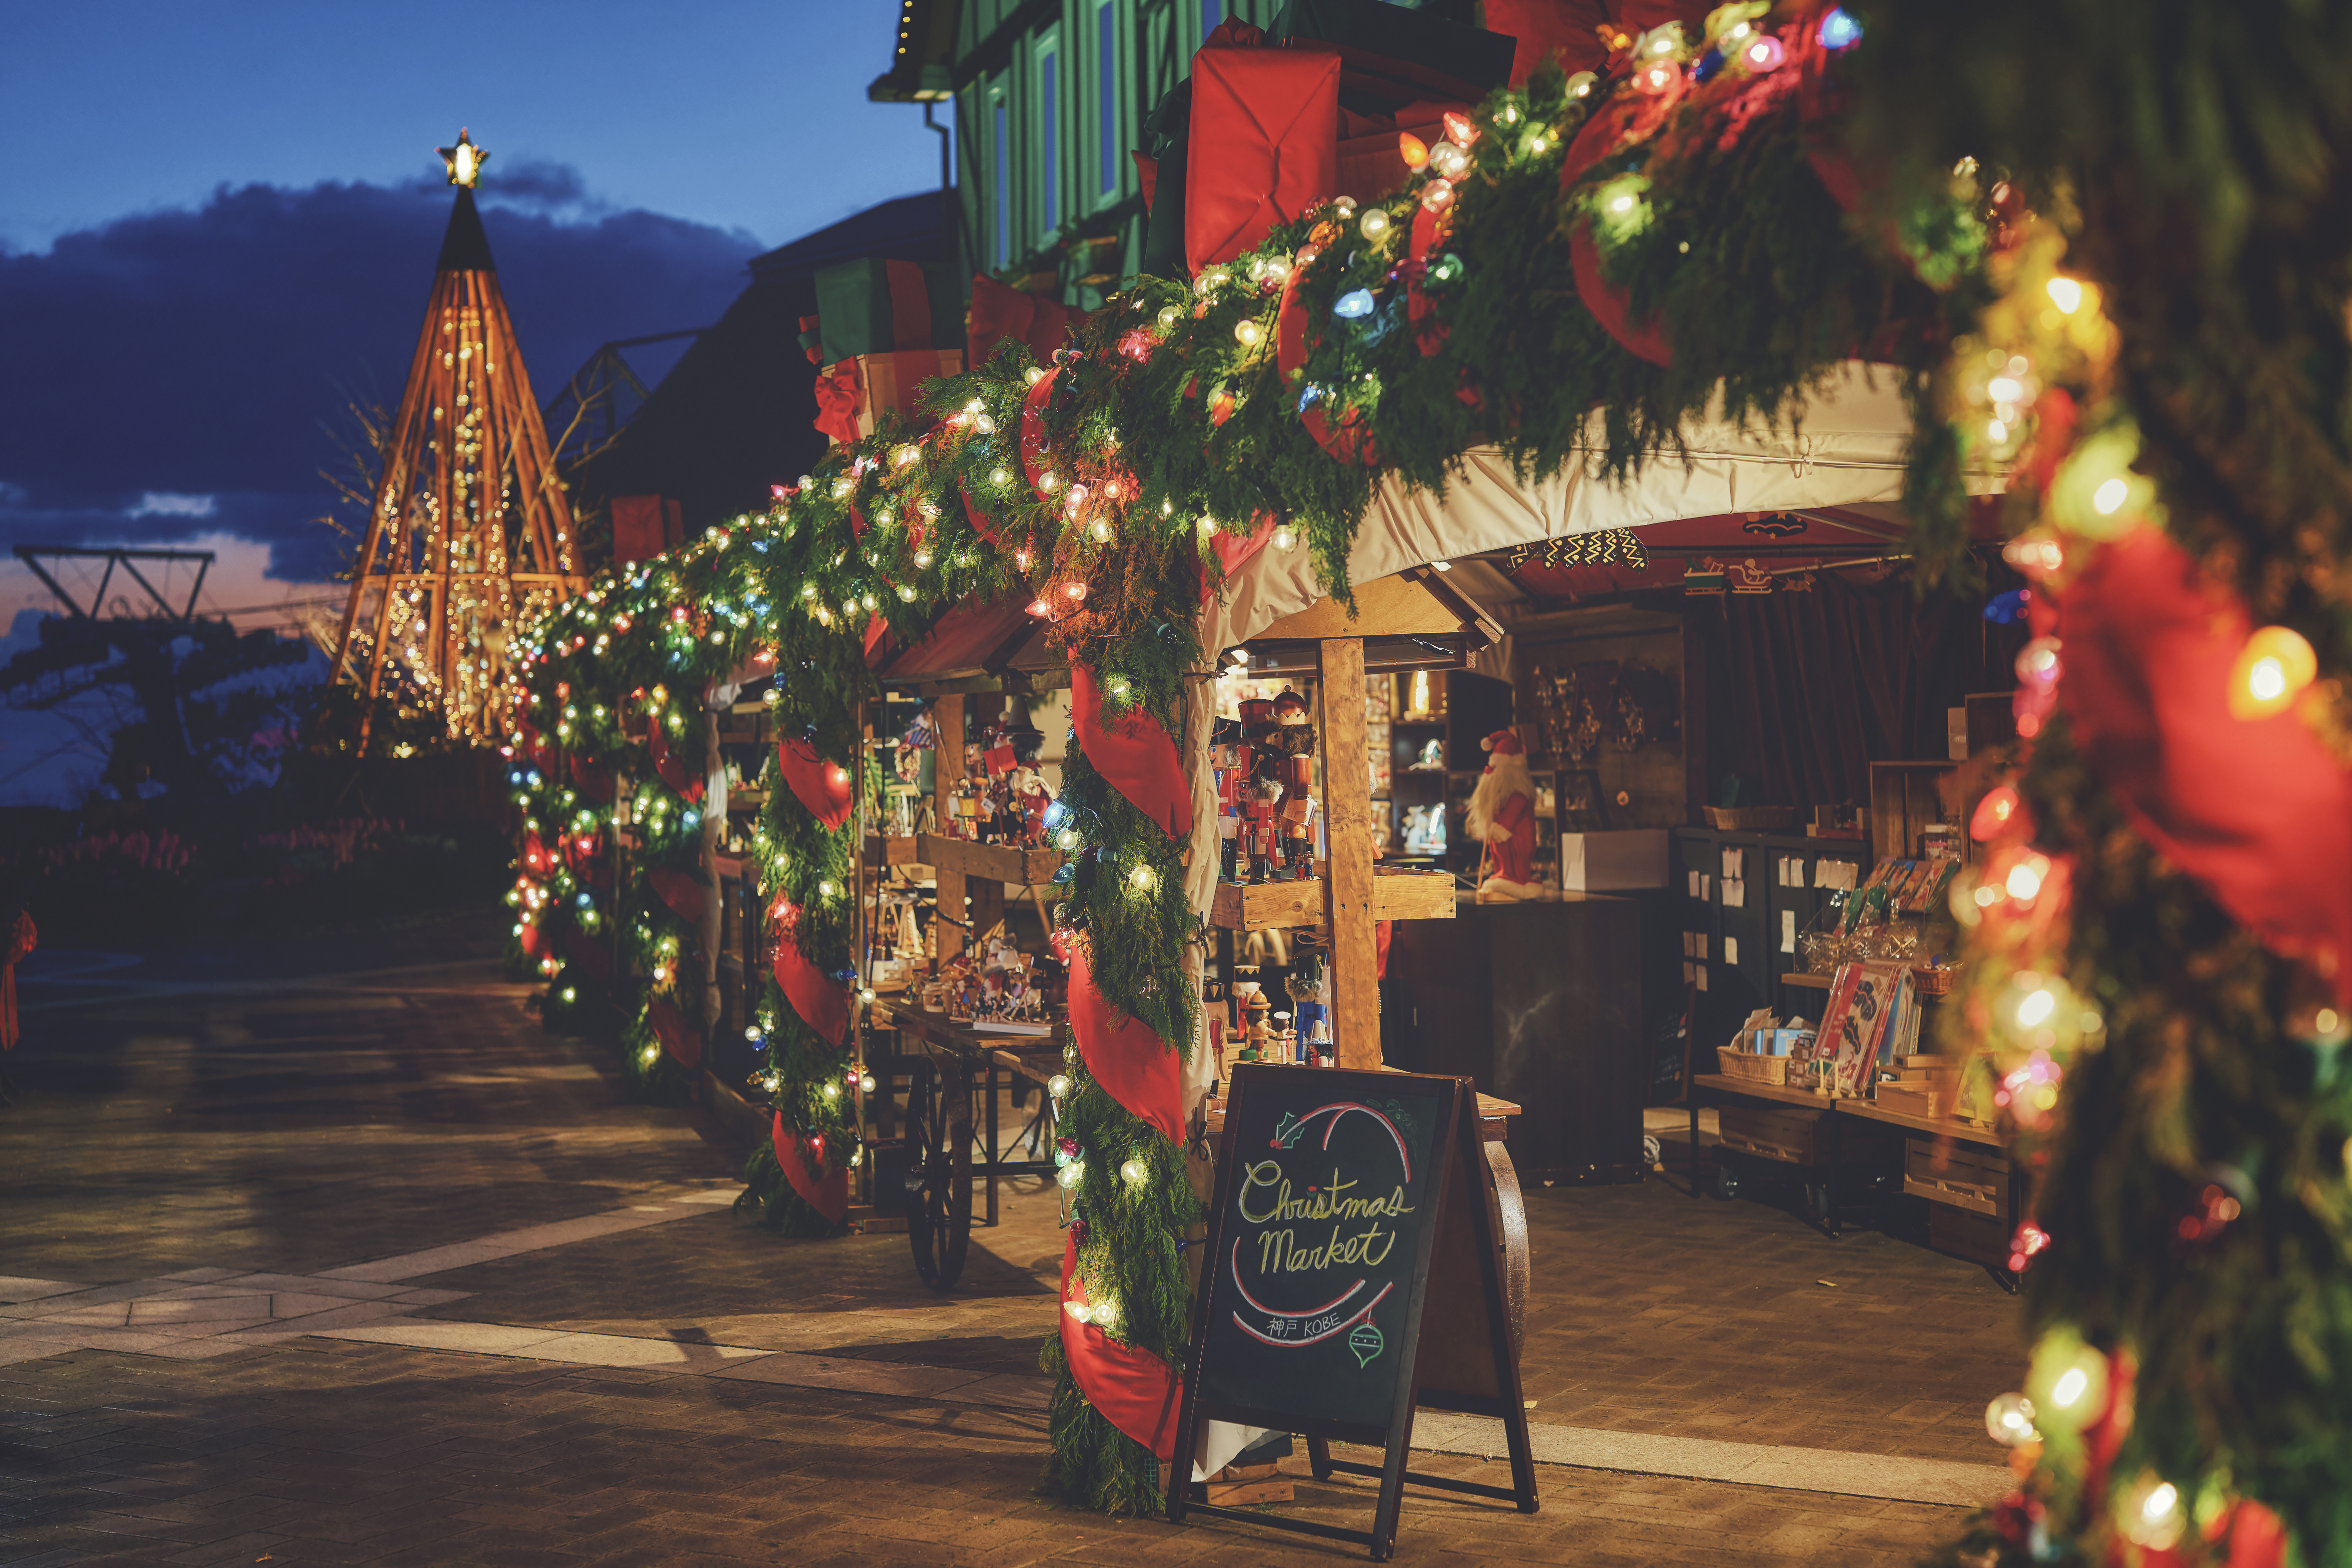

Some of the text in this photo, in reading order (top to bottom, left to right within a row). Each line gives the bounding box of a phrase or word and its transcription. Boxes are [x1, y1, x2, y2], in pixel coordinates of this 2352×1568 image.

[1239, 1160, 1415, 1223] Christmas
[1258, 1222, 1396, 1274] Market
[1267, 1312, 1341, 1337] 神戸 KOBE
